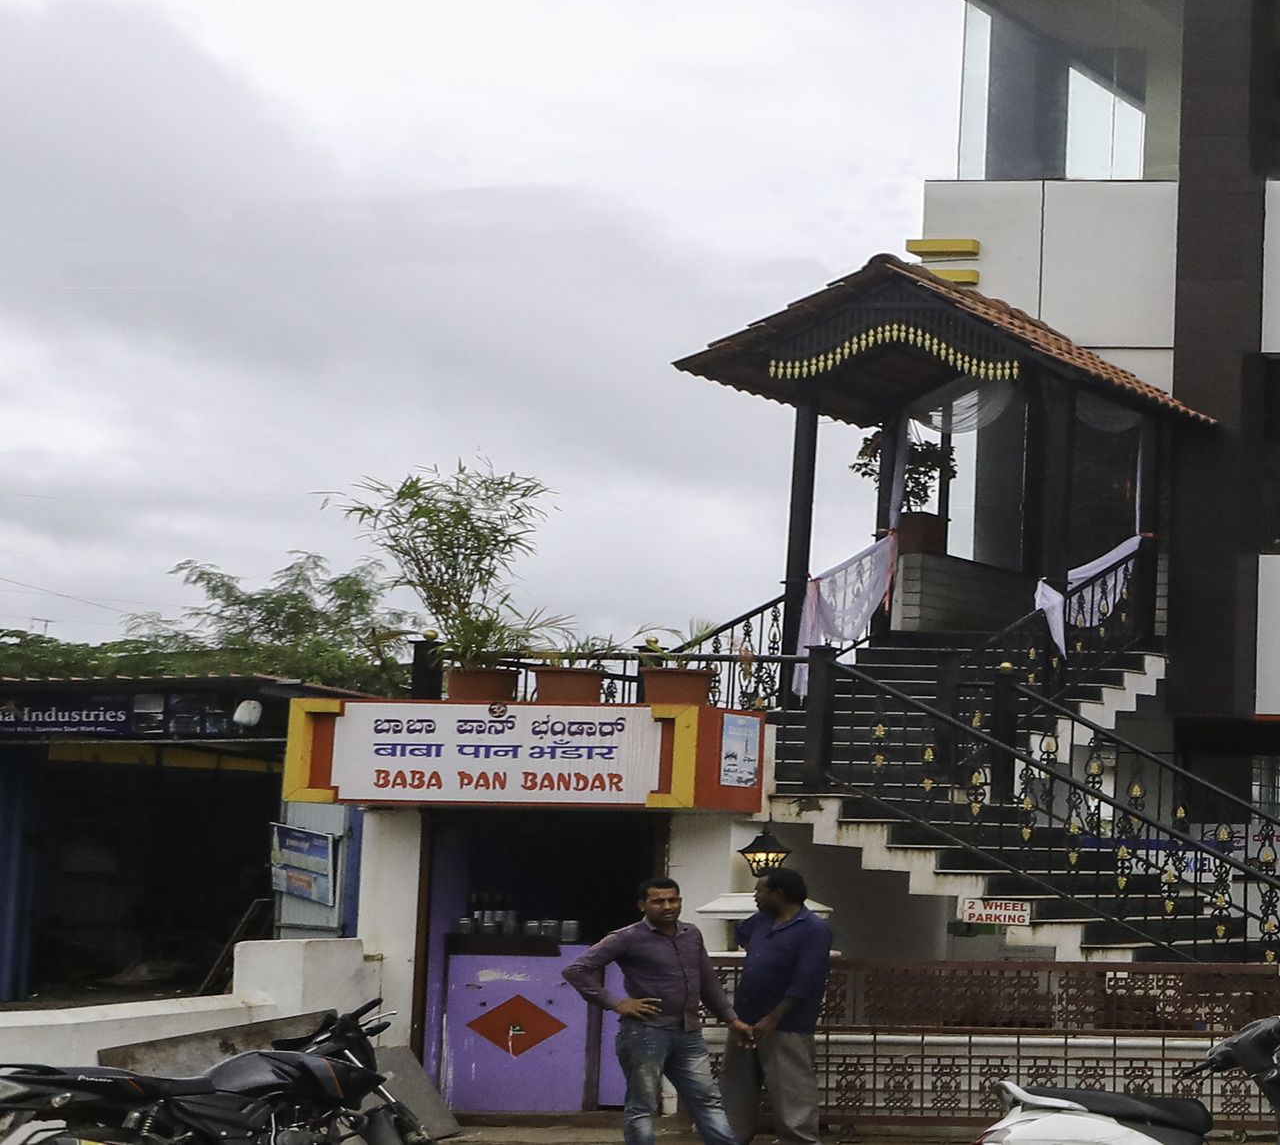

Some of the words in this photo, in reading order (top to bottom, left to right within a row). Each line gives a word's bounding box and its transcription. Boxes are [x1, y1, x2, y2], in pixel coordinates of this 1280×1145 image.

[23, 707, 126, 722] Industries
[373, 719, 436, 735] ಬಾಬಾ
[456, 715, 516, 735] ಪಾನ್
[373, 743, 444, 757] बाबा
[456, 744, 522, 759] पान
[373, 769, 443, 790] BABA
[457, 770, 507, 790] PAN
[521, 771, 623, 792] BANDAR
[968, 901, 976, 910] 2
[983, 901, 1027, 912] WHEEL
[968, 913, 1026, 924] PARKING
